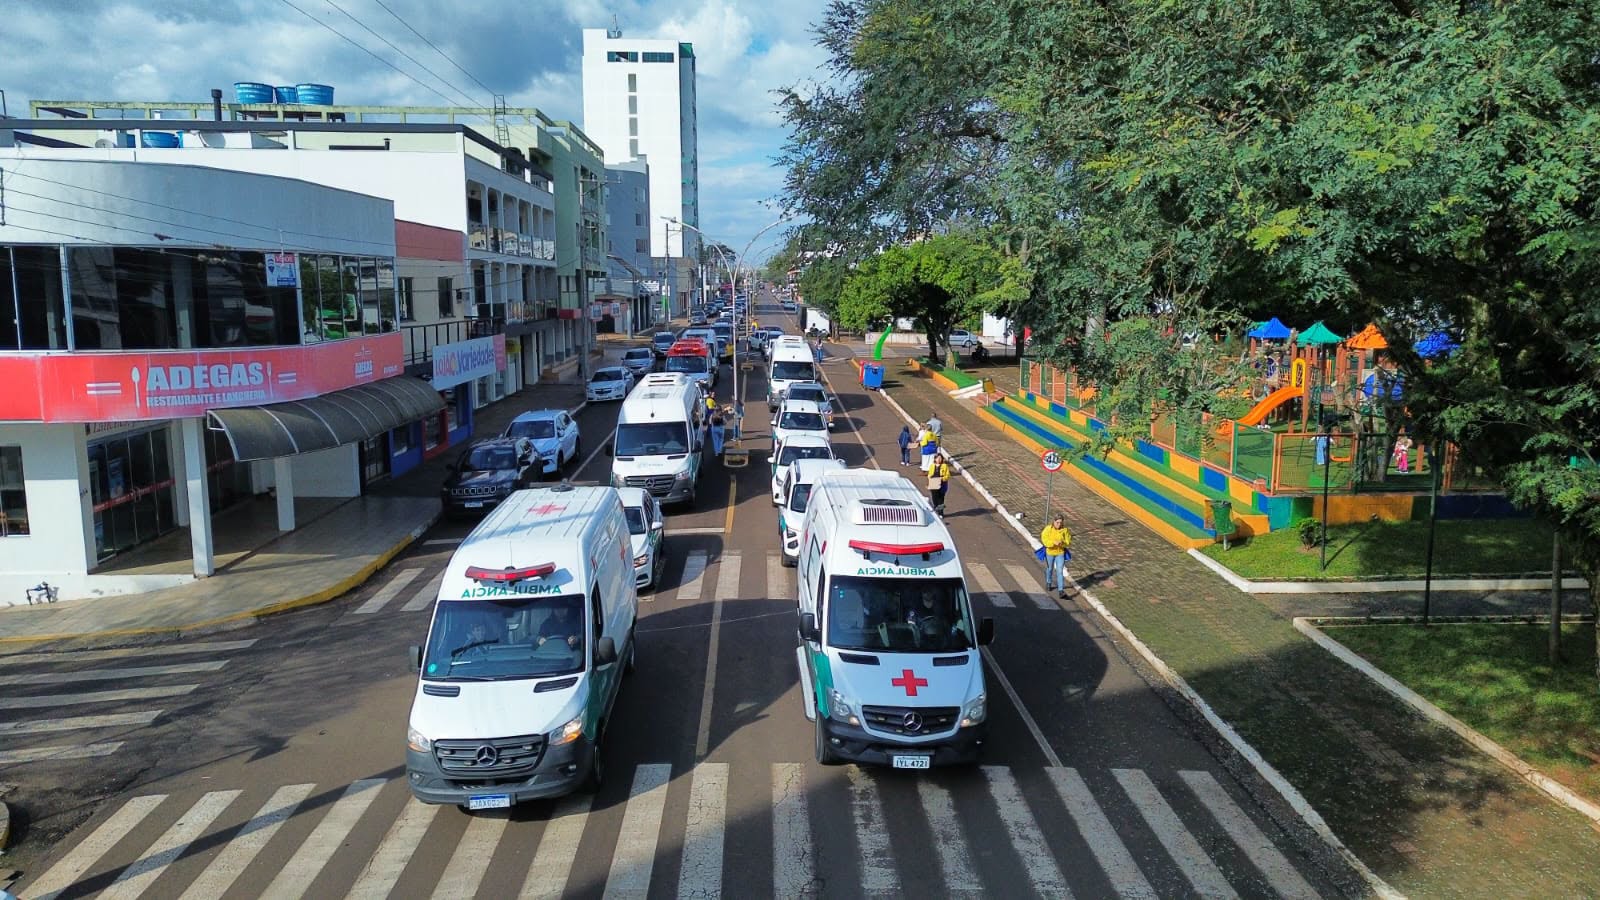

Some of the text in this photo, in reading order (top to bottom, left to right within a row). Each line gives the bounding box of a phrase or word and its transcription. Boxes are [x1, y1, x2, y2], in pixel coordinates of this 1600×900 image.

[147, 362, 264, 392] ADEGAS
[147, 393, 213, 408] RESTAURANTE
[215, 394, 221, 404] E
